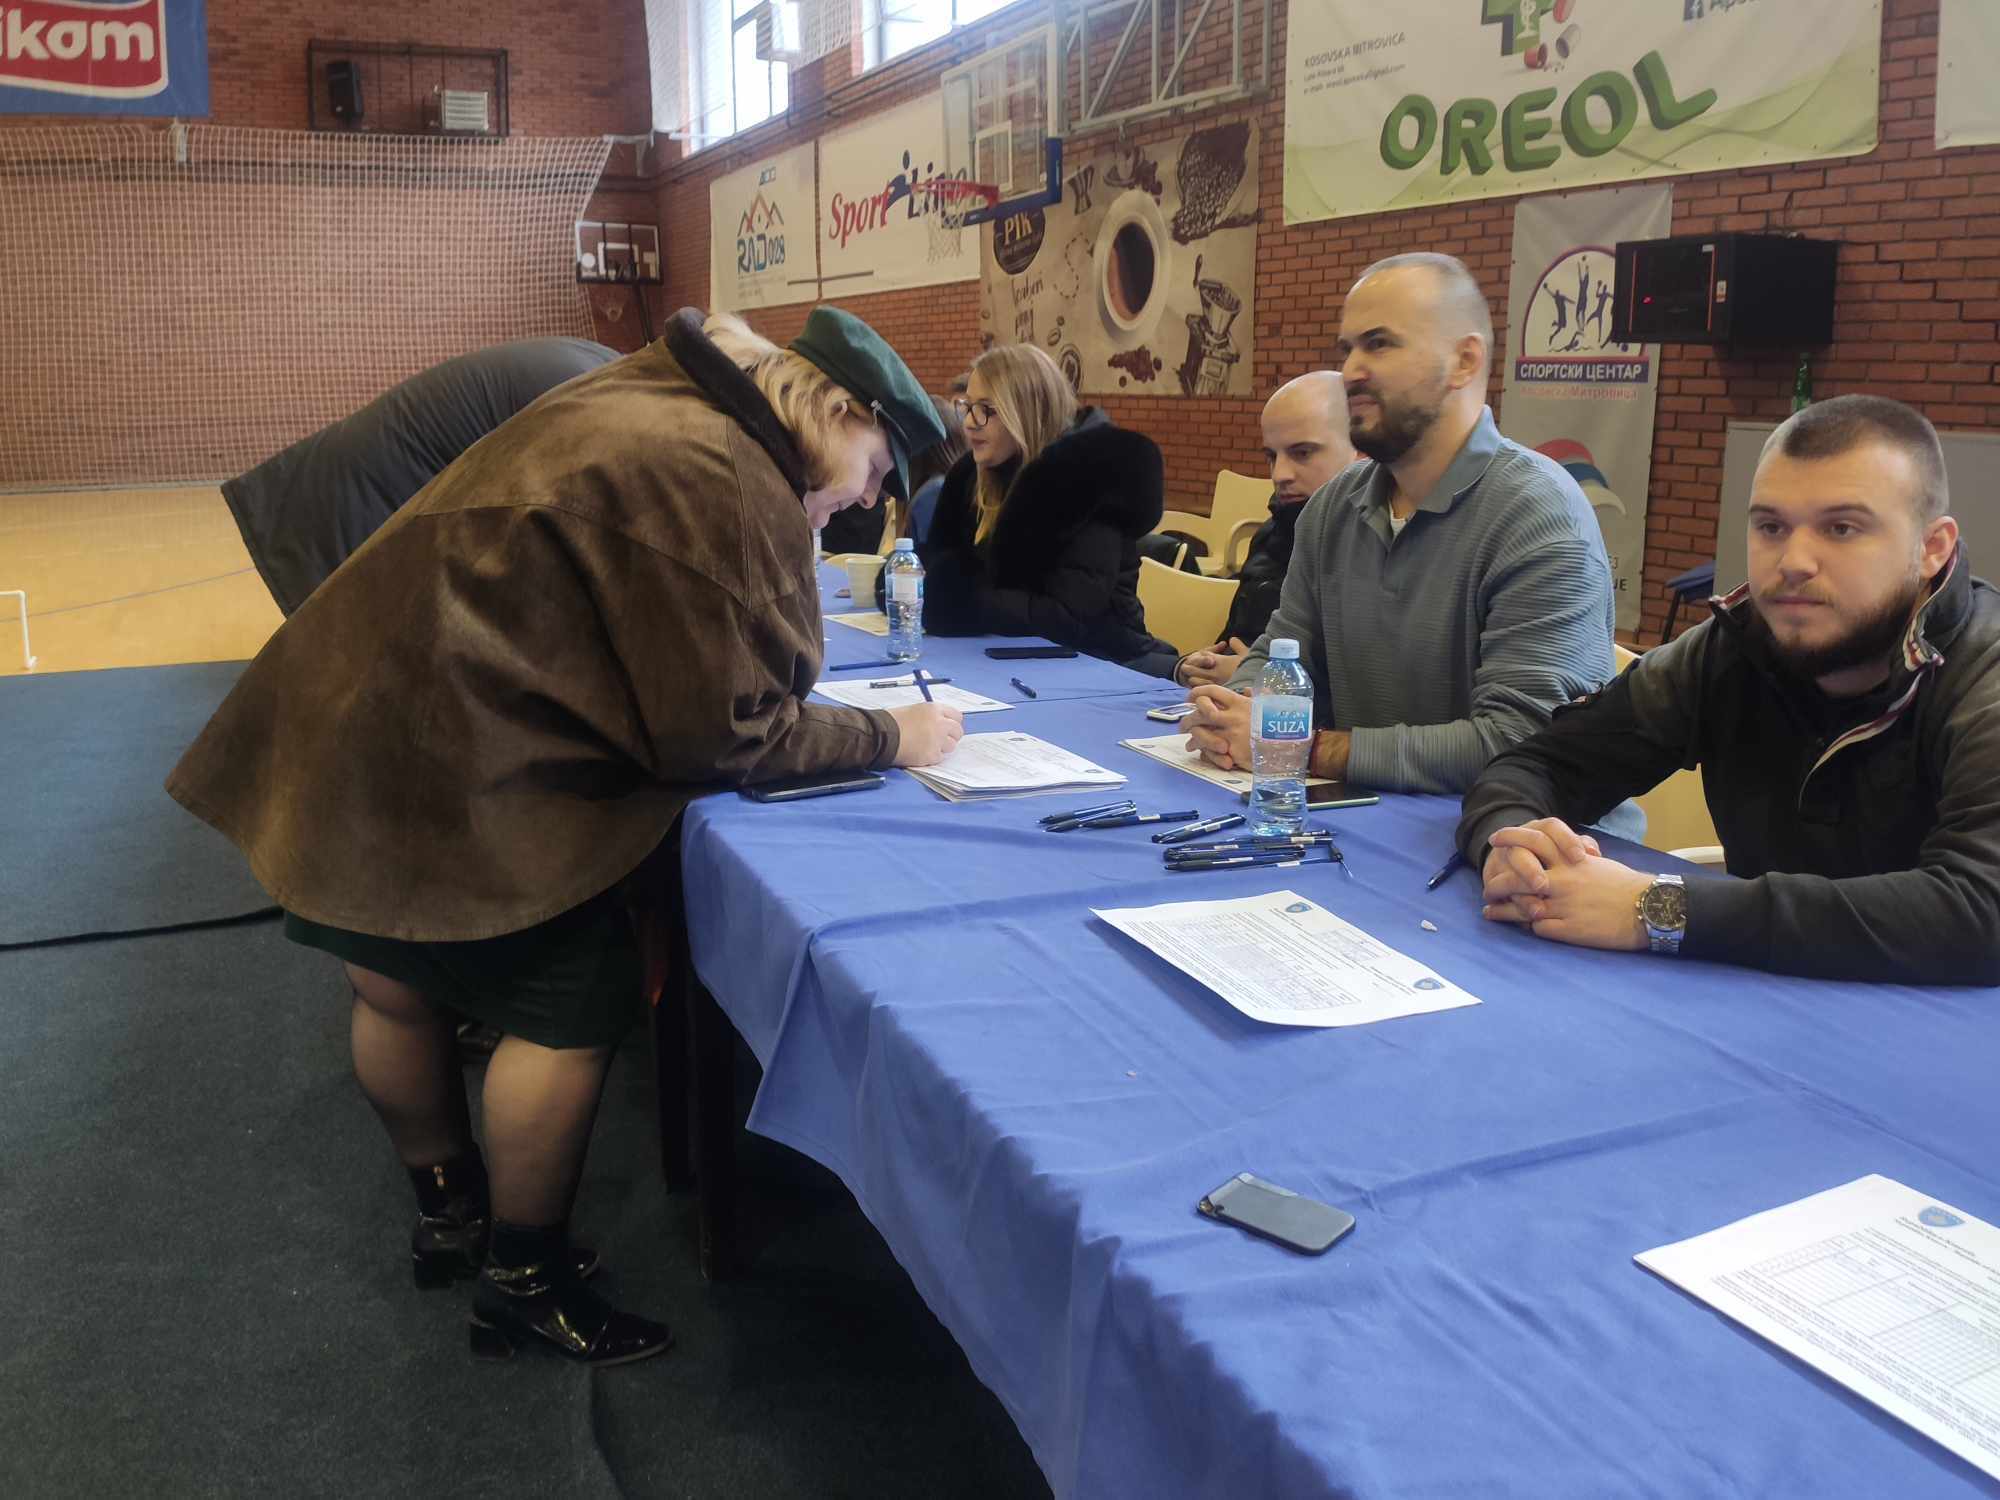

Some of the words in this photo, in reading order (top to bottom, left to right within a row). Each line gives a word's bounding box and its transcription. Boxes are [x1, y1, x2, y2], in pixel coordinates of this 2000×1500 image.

[1380, 50, 1718, 176] OREOL
[828, 180, 893, 249] Sport
[1520, 363, 1584, 379] СПОРТСКИ
[1586, 363, 1642, 383] ЦЕНТАР
[1266, 720, 1306, 733] SUZA
